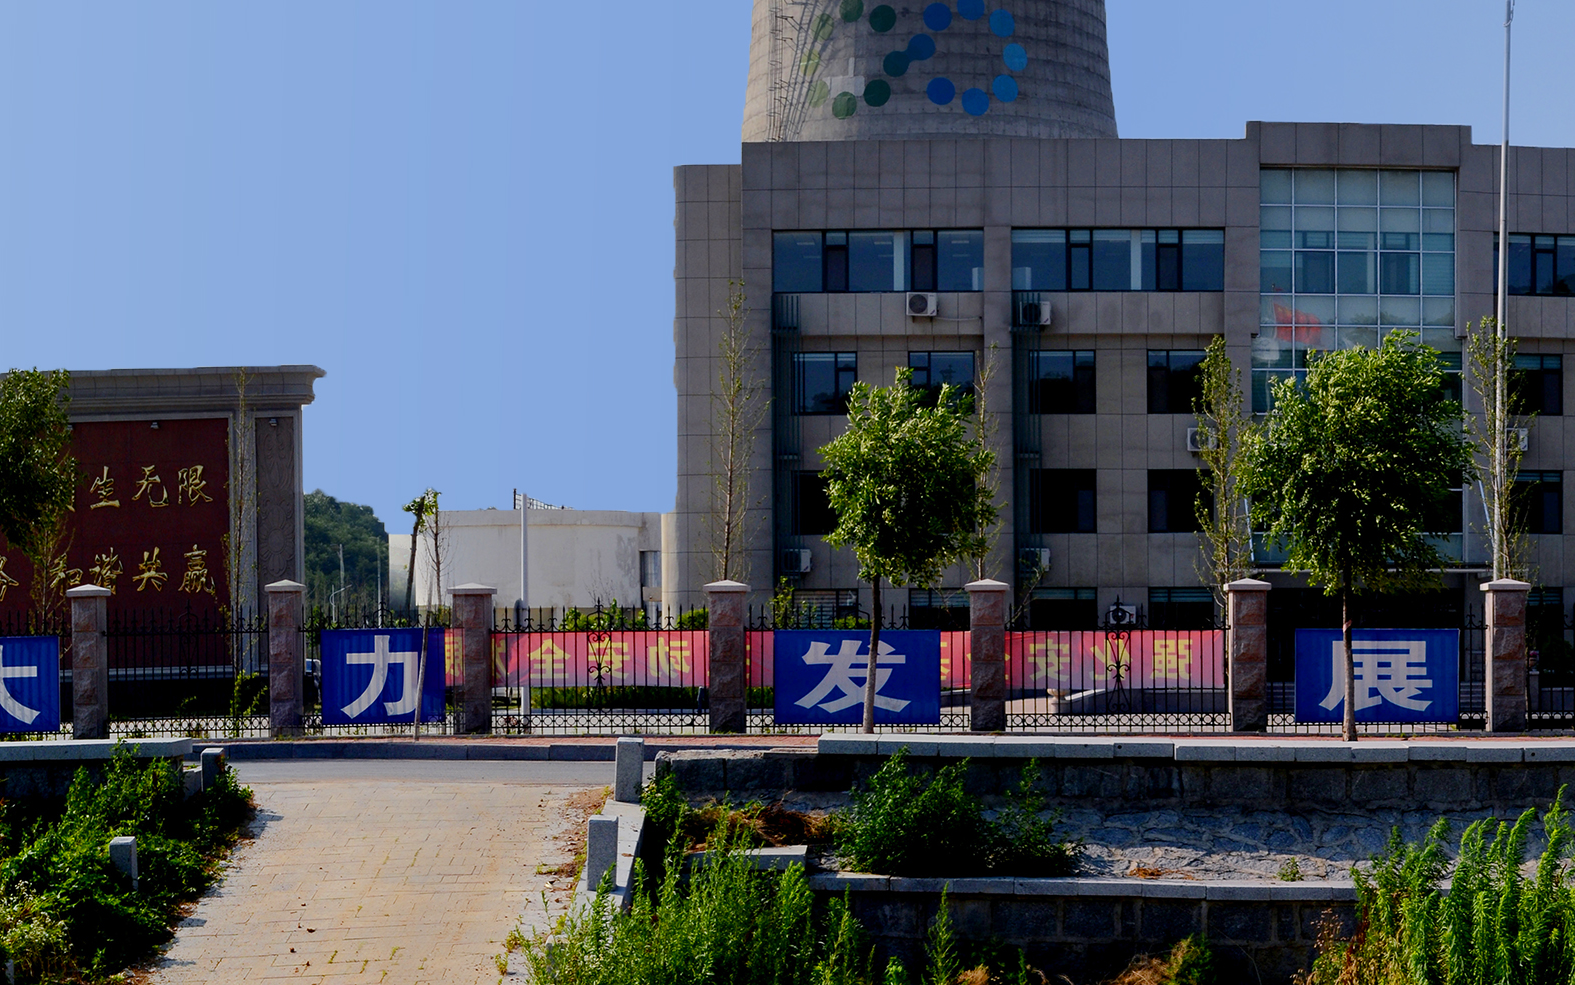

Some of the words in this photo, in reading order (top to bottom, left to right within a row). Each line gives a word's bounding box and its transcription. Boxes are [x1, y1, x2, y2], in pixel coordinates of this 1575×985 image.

[49, 543, 217, 597] 和谐共赢
[340, 634, 420, 718] 力
[795, 639, 911, 715] 发
[1319, 639, 1433, 712] 展
